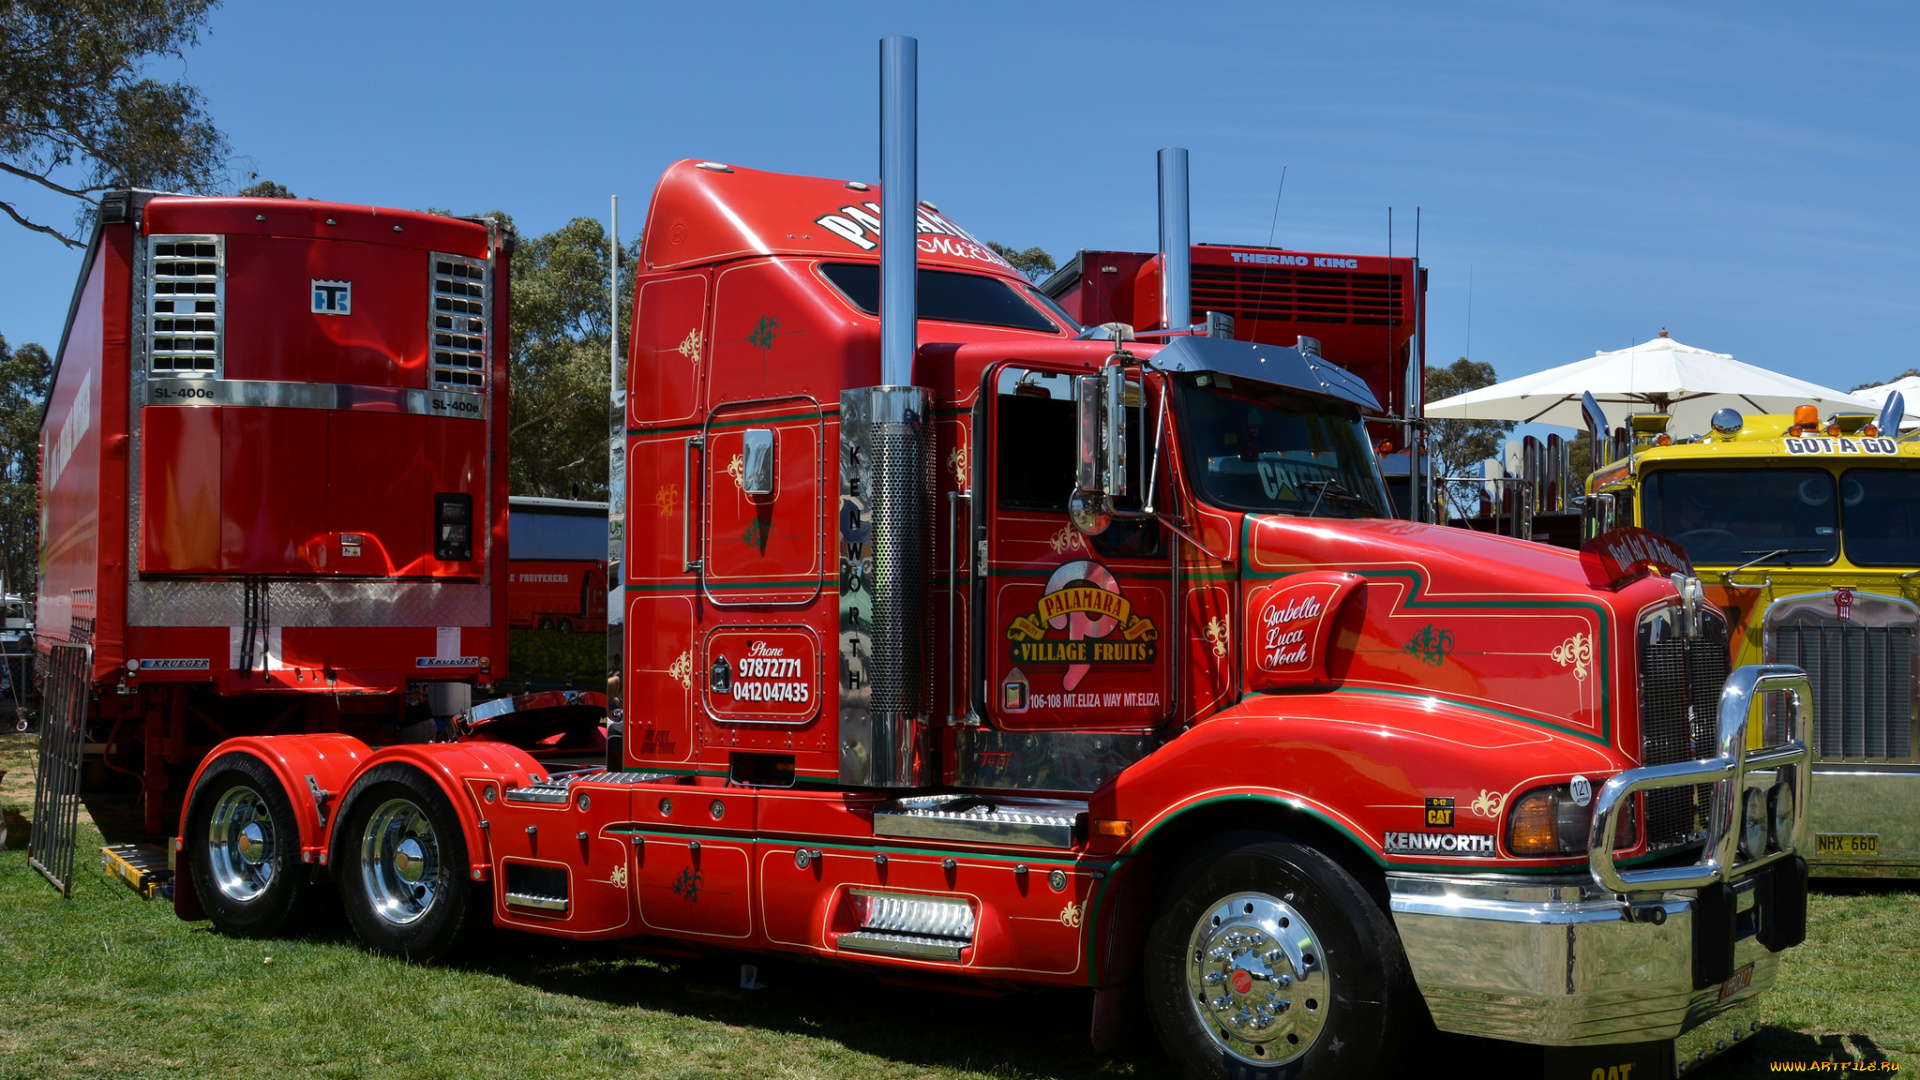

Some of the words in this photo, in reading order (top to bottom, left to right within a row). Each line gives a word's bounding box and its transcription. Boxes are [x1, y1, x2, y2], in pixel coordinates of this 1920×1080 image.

[1231, 252, 1309, 267] THERMO
[1314, 257, 1358, 269] KING
[154, 387, 214, 399] SL-400e
[432, 399, 480, 413] SL-400e
[1784, 437, 1897, 455] GOT-A-GO
[847, 446, 862, 690] KENWORTH
[519, 573, 569, 583] FRUITERERS
[1044, 590, 1122, 617] PALAMARA
[1263, 596, 1321, 628] Isabella
[1019, 620, 1038, 636] QUALITY
[1265, 626, 1304, 649] Luca
[748, 640, 784, 657] Phone
[1021, 643, 1086, 661] VILLAGE
[1094, 643, 1147, 661] FRUITS
[1265, 643, 1308, 669] Noah
[739, 658, 801, 678] 97872771
[1030, 694, 1061, 708] 106-108
[1063, 694, 1100, 707] MT.ELIZA
[1103, 693, 1122, 707] WAY
[1124, 692, 1160, 706] MT.ELIZA
[1573, 780, 1589, 797] 121
[1428, 809, 1451, 824] CAT
[1384, 832, 1494, 851] KENWORTH
[1592, 1063, 1632, 1080] CAT
